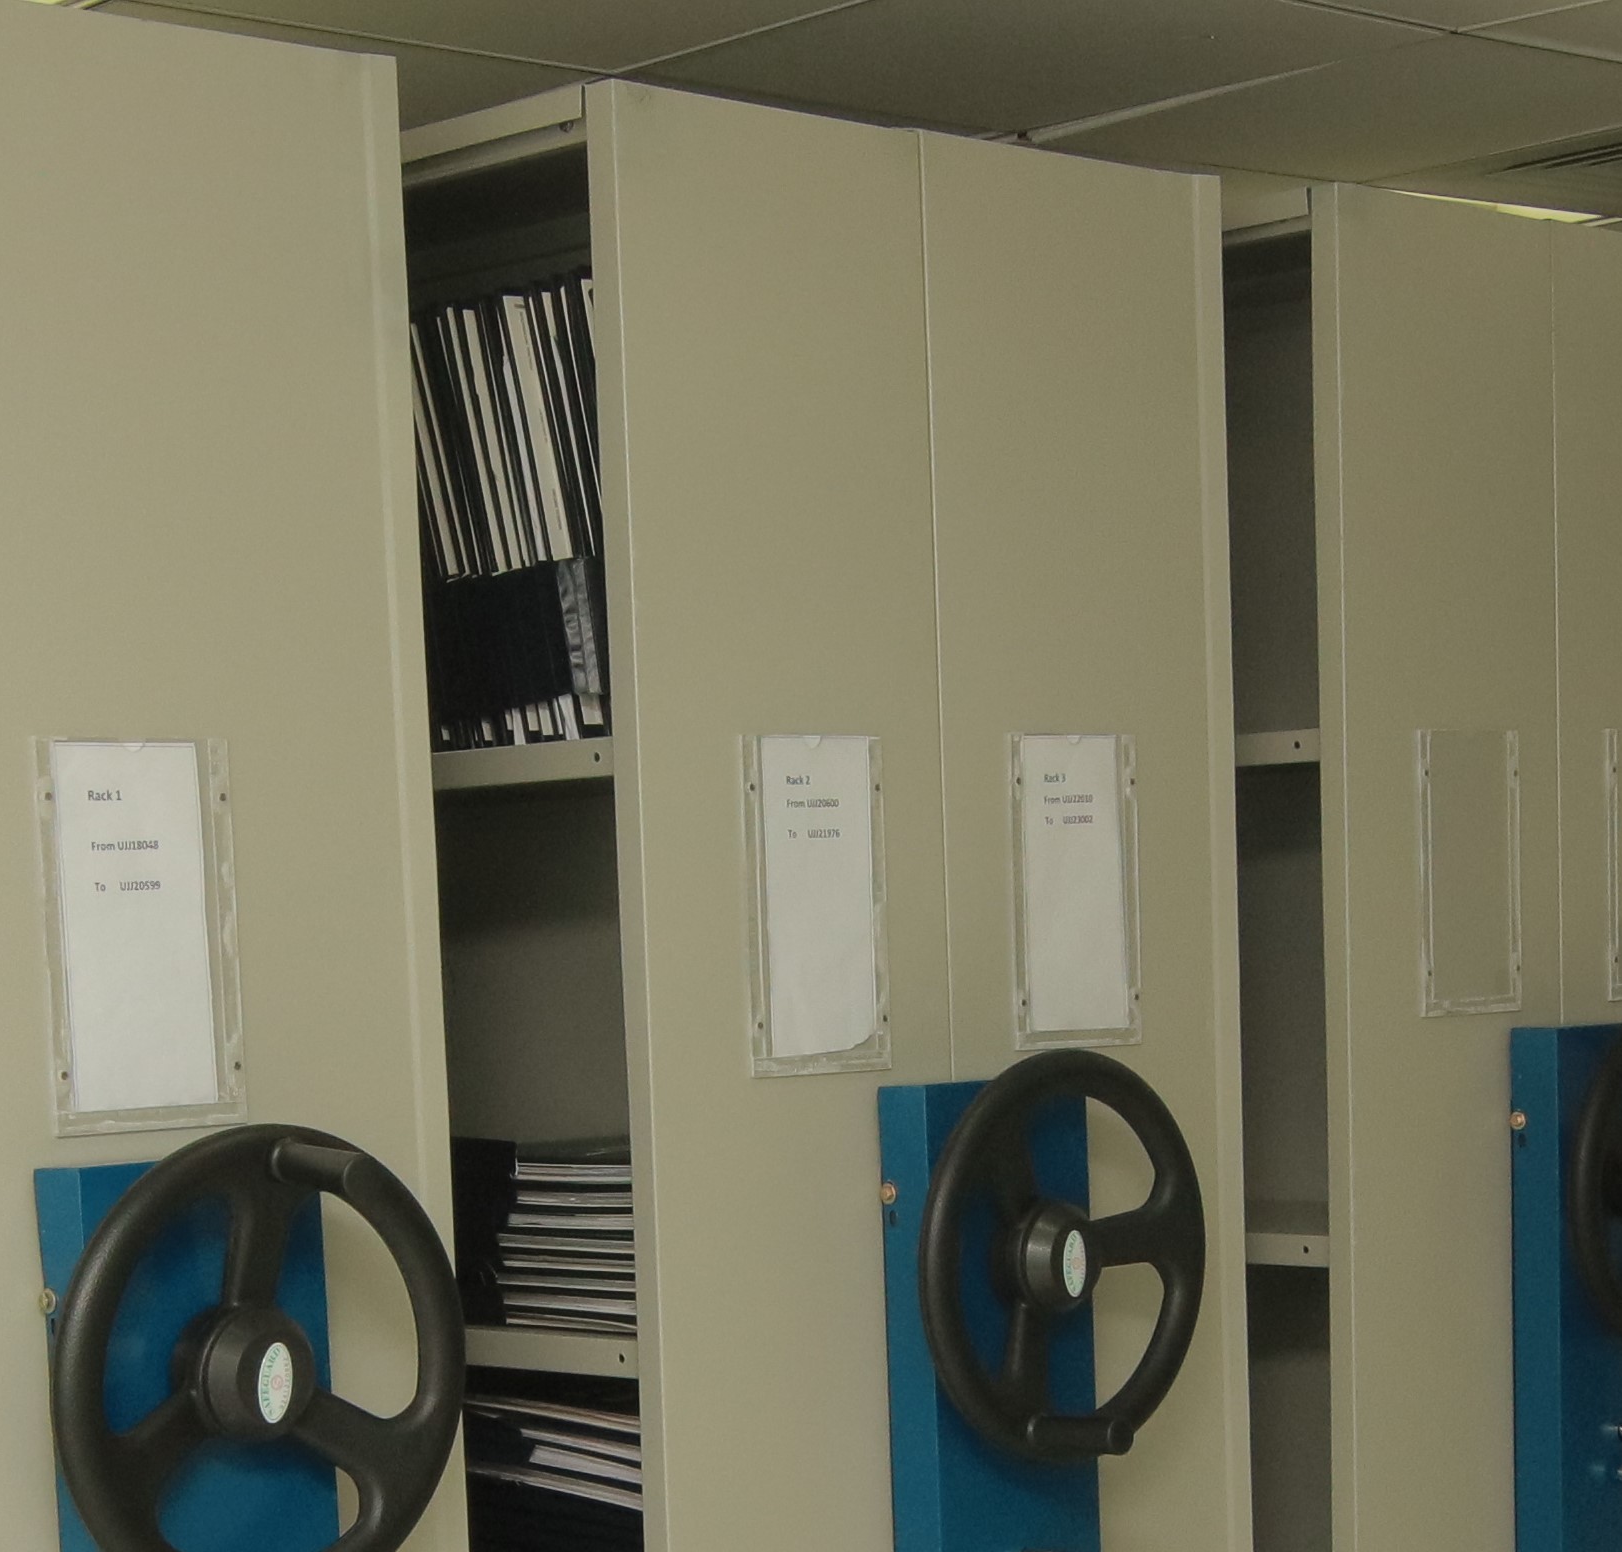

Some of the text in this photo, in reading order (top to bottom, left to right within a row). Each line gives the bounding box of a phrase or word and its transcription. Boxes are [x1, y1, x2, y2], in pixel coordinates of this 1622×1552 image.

[786, 775, 810, 785] Rack 2
[1043, 773, 1066, 783] Rack 3
[88, 790, 122, 801] Rack 1
[1043, 795, 1060, 804] From
[786, 799, 806, 808] From
[1044, 816, 1054, 825] To
[787, 829, 798, 838] To
[91, 841, 115, 851] From
[94, 882, 106, 892] To
